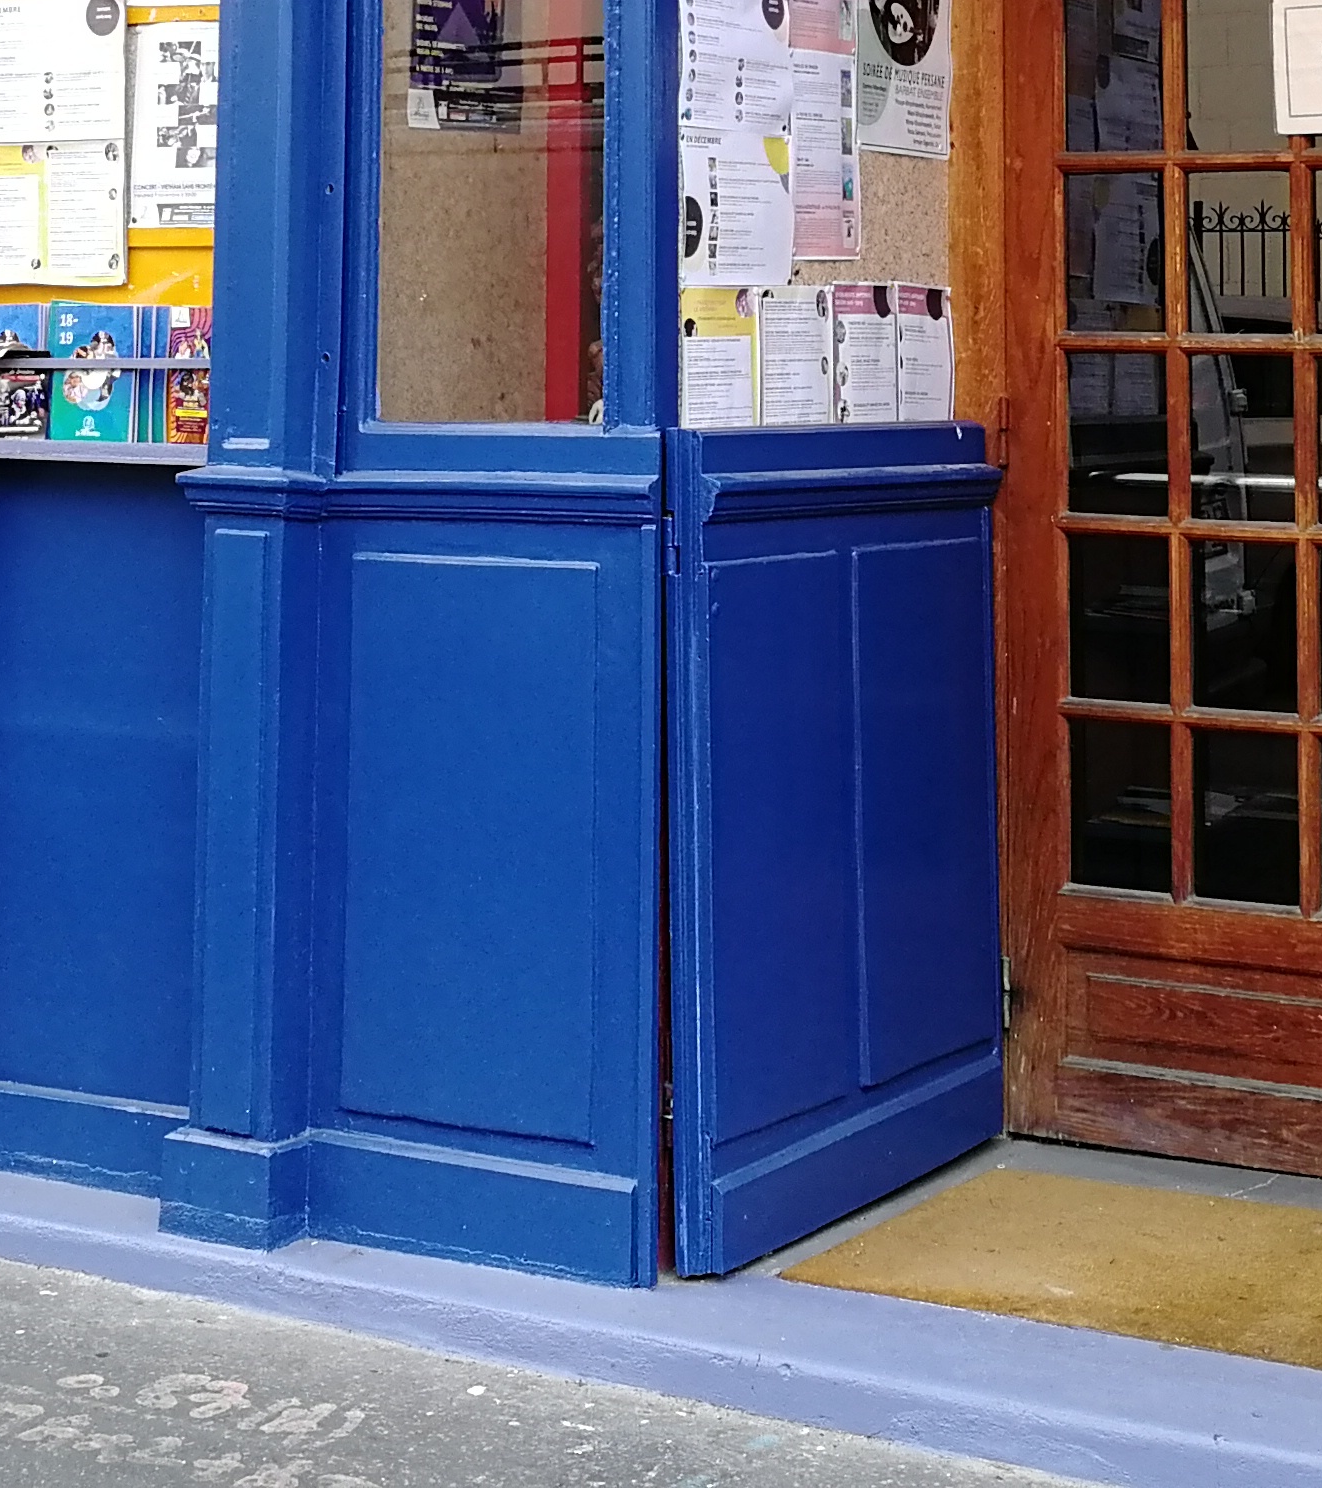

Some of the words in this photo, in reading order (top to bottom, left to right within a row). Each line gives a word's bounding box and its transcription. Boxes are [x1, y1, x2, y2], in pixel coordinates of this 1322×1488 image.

[884, 65, 893, 81] DE
[894, 68, 920, 86] MUSIQUE
[921, 71, 945, 89] PERSANE
[685, 135, 693, 143] EN
[694, 133, 722, 145] DÉCEMBRE
[59, 332, 74, 345] 19
